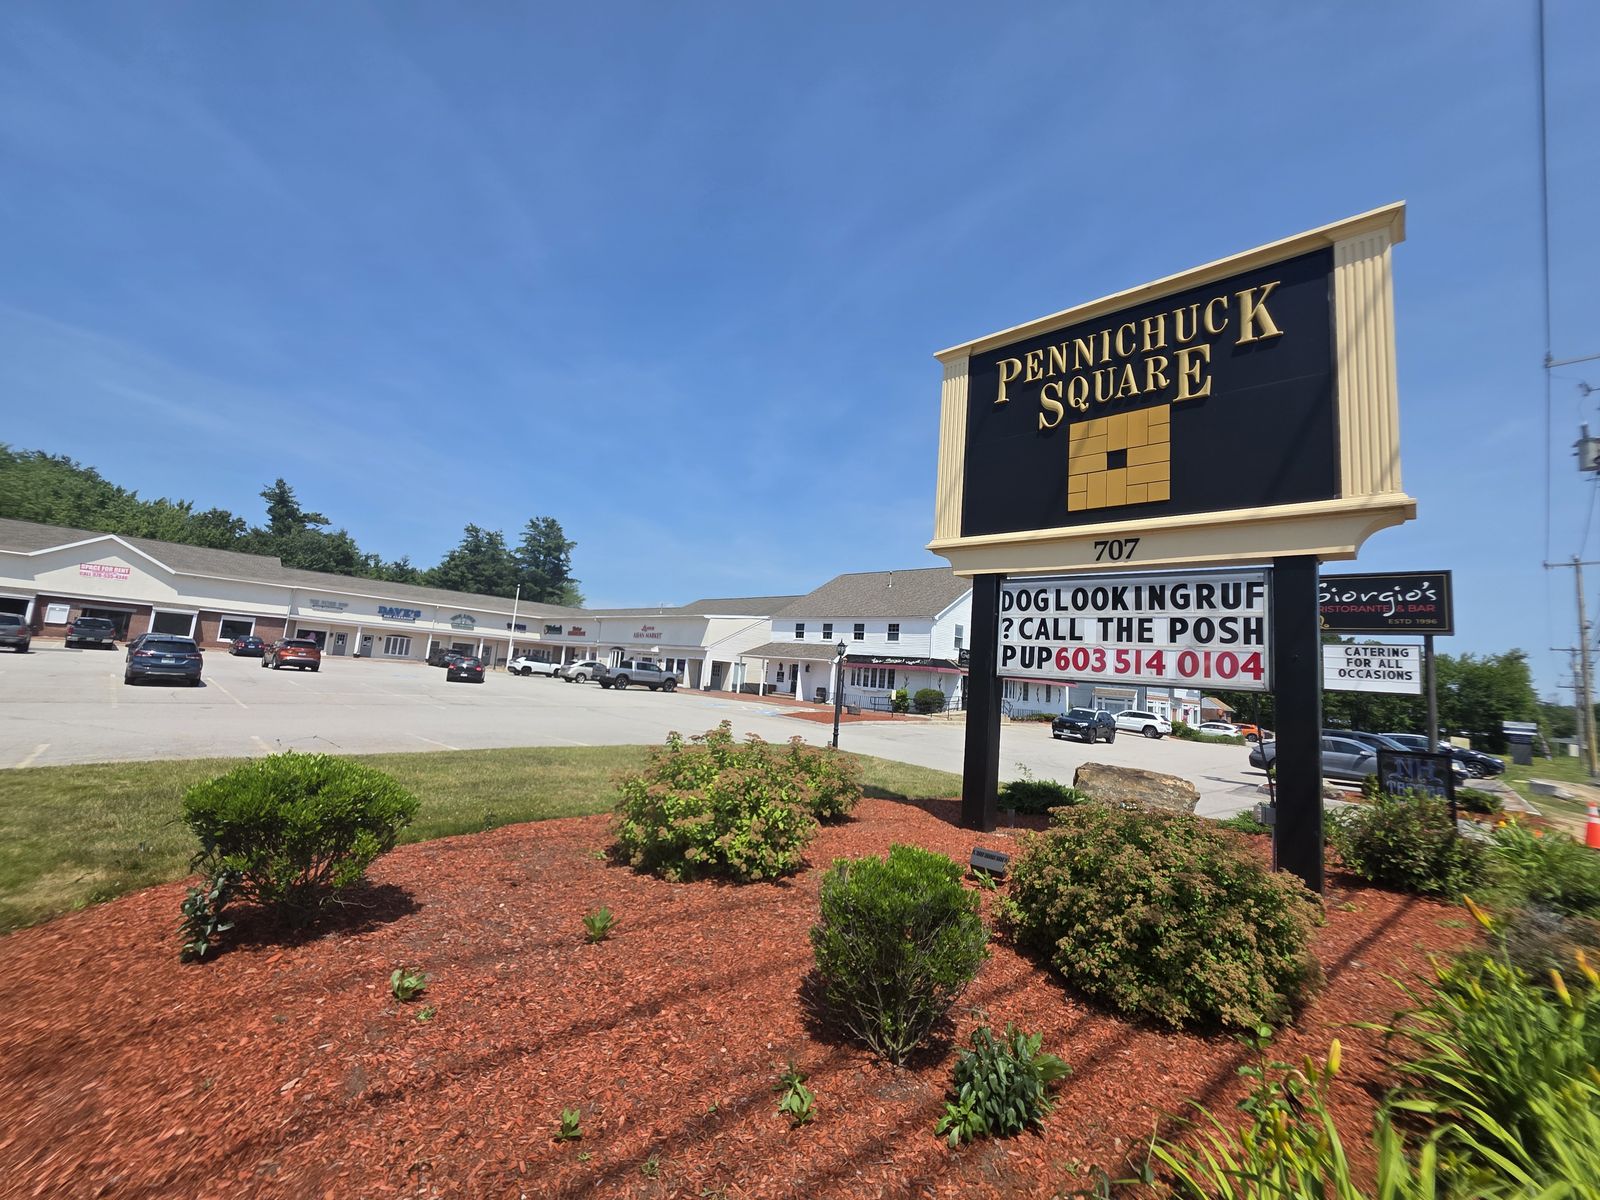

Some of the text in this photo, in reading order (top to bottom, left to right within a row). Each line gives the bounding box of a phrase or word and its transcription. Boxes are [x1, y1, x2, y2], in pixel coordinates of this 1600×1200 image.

[994, 281, 1284, 404] PENNICHUCK
[1038, 344, 1212, 430] SQUARE
[1094, 538, 1140, 561] 707
[377, 605, 422, 617] DAVE'S
[1396, 604, 1405, 613] &
[1408, 604, 1436, 612] BAR
[1097, 617, 1154, 643] THE
[1169, 616, 1264, 645] POSH
[1344, 647, 1409, 657] CATERING
[1002, 645, 1264, 680] PUP 603 514 0104
[1346, 658, 1403, 668] FOR ALL
[1338, 669, 1412, 680] OCCASIONS
